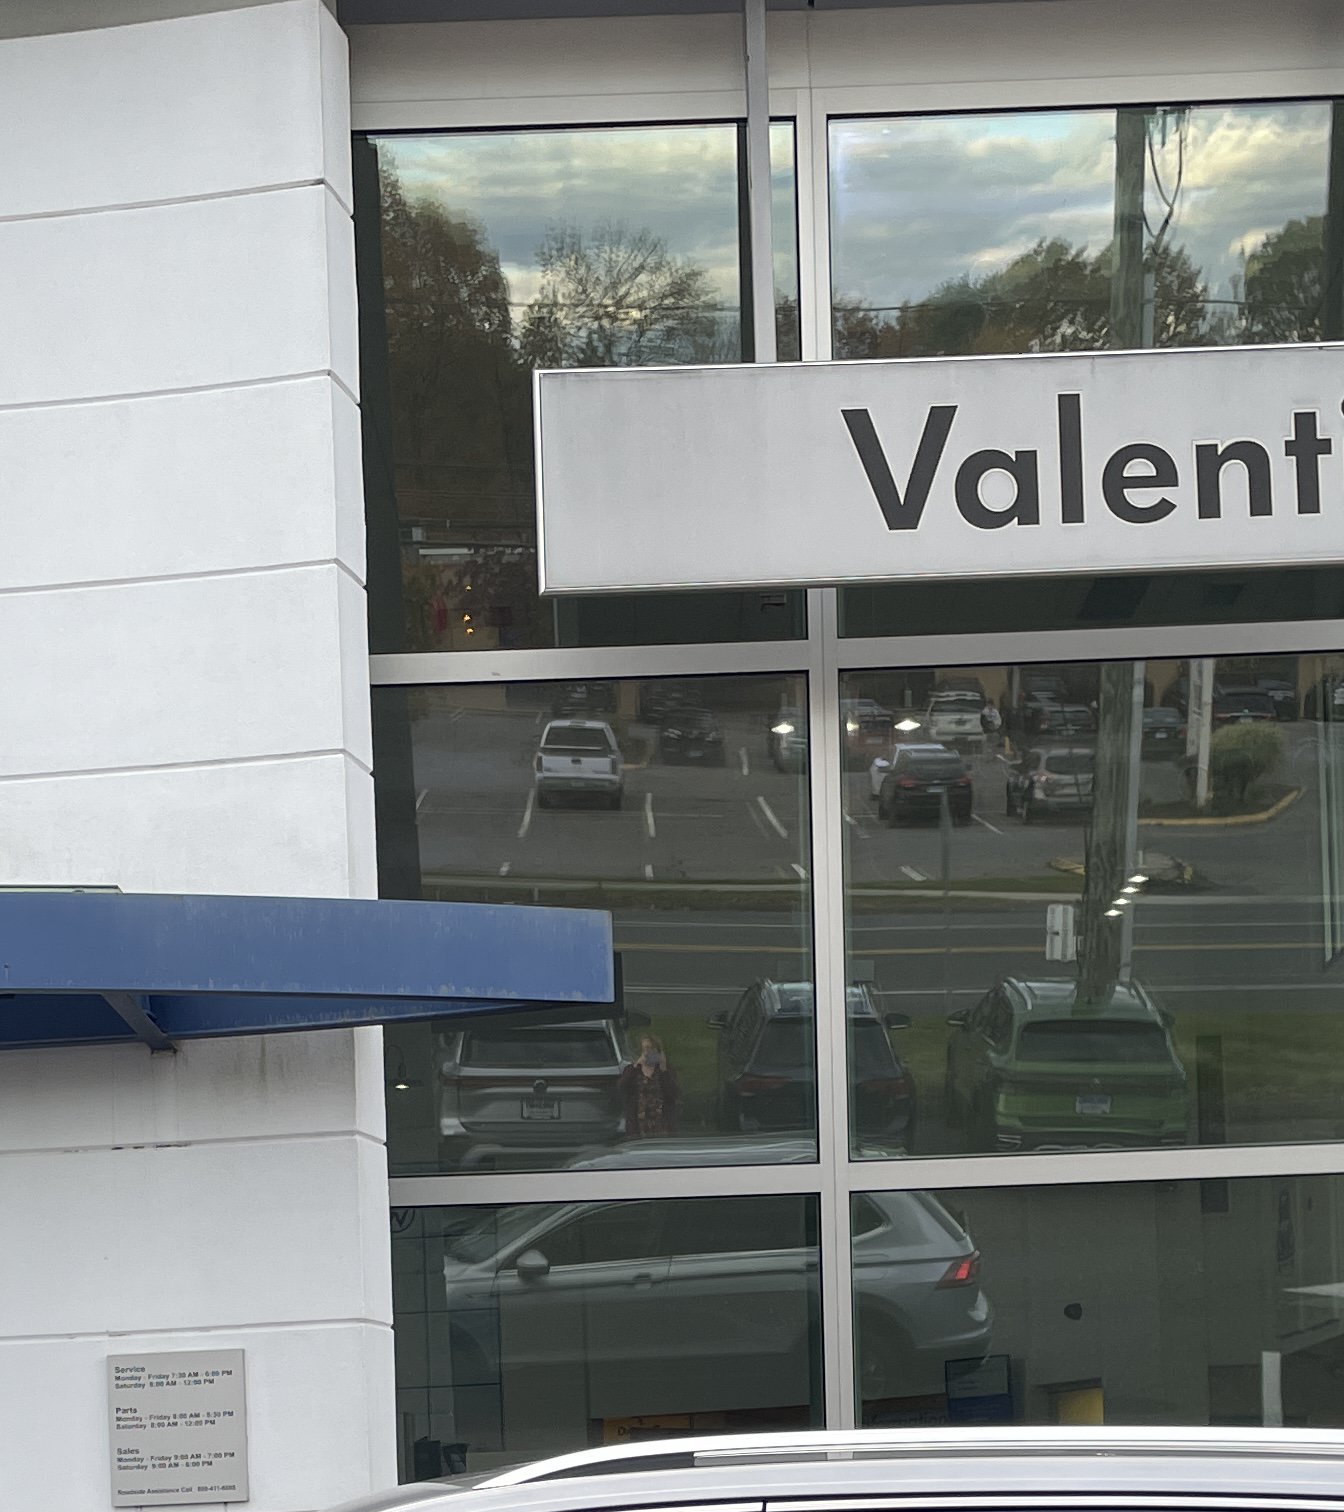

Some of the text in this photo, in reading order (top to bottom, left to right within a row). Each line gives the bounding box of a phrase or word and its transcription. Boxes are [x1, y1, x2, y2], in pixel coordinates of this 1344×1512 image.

[114, 1366, 146, 1374] Service
[114, 1374, 142, 1382] Monday
[114, 1382, 146, 1390] Saturday
[117, 1463, 148, 1471] Saturday
